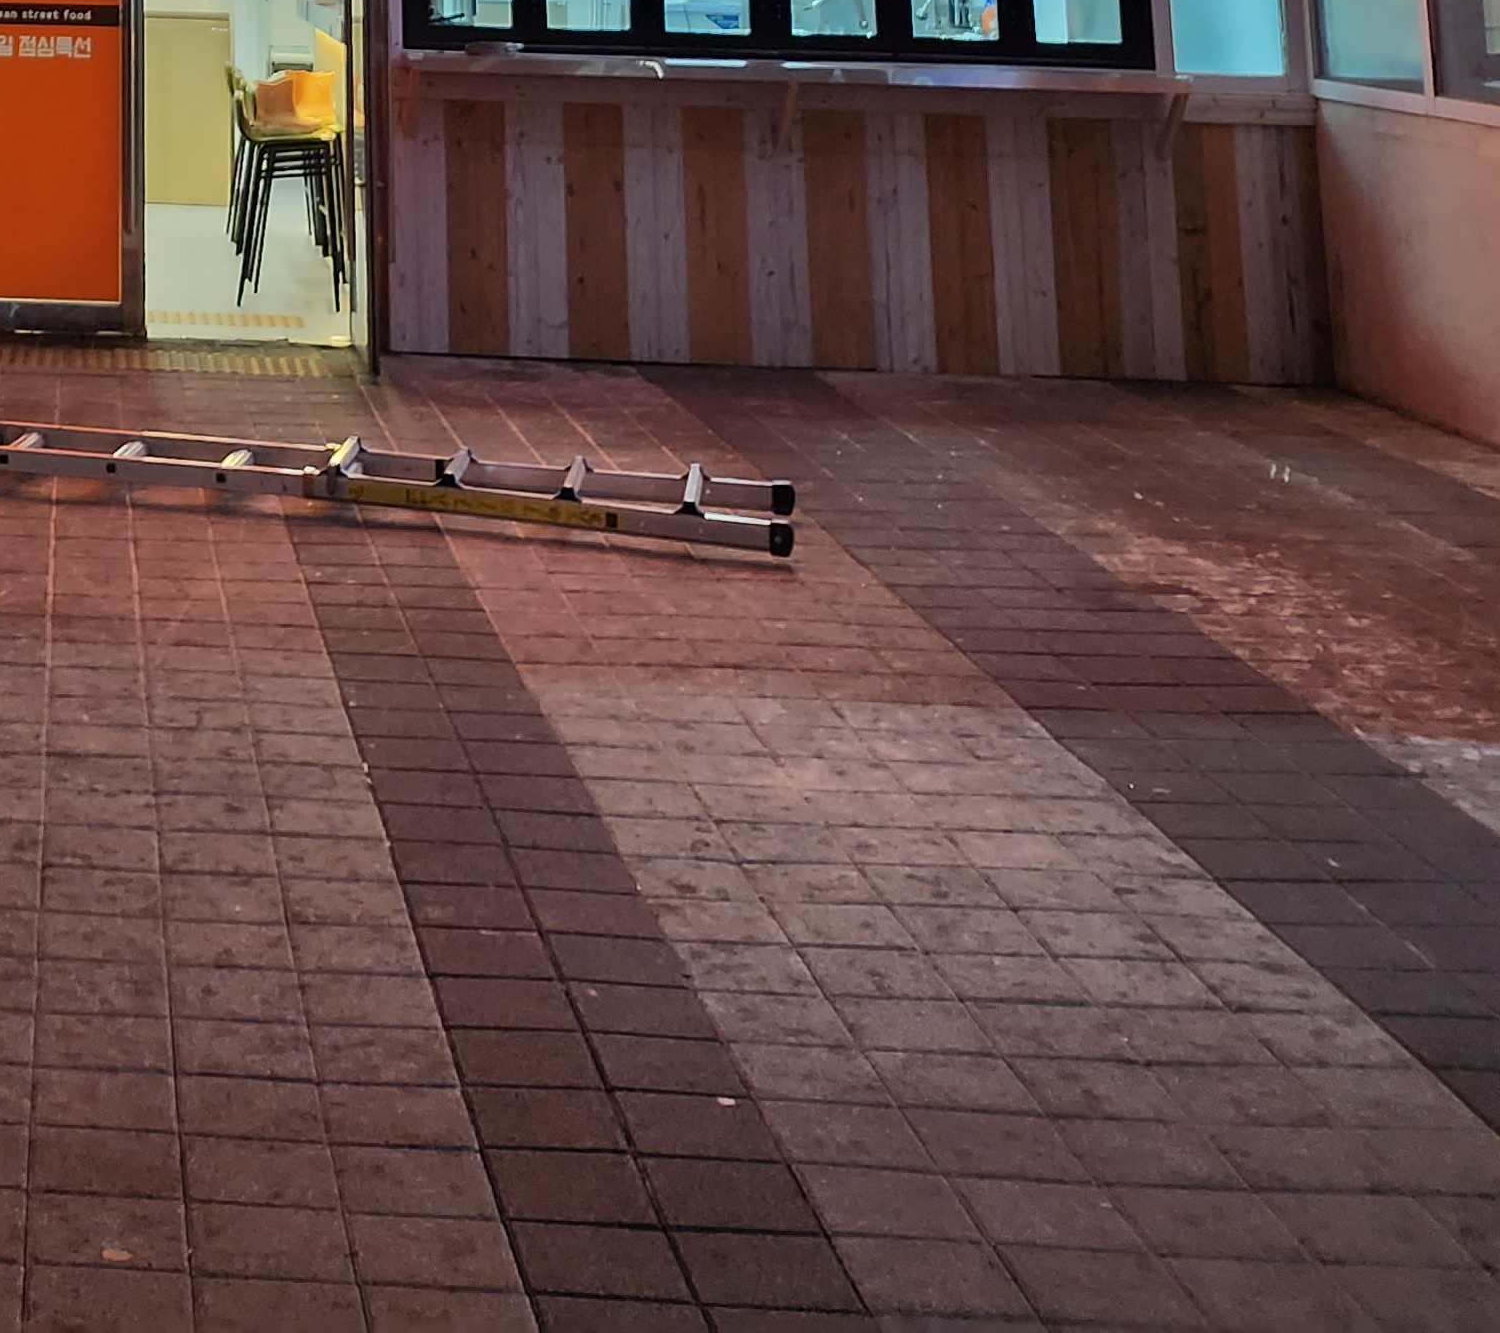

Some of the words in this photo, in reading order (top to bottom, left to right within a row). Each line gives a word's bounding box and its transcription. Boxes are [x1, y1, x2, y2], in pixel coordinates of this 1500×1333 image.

[21, 9, 60, 20] street
[63, 9, 92, 21] food
[18, 34, 92, 59] 점심특선
